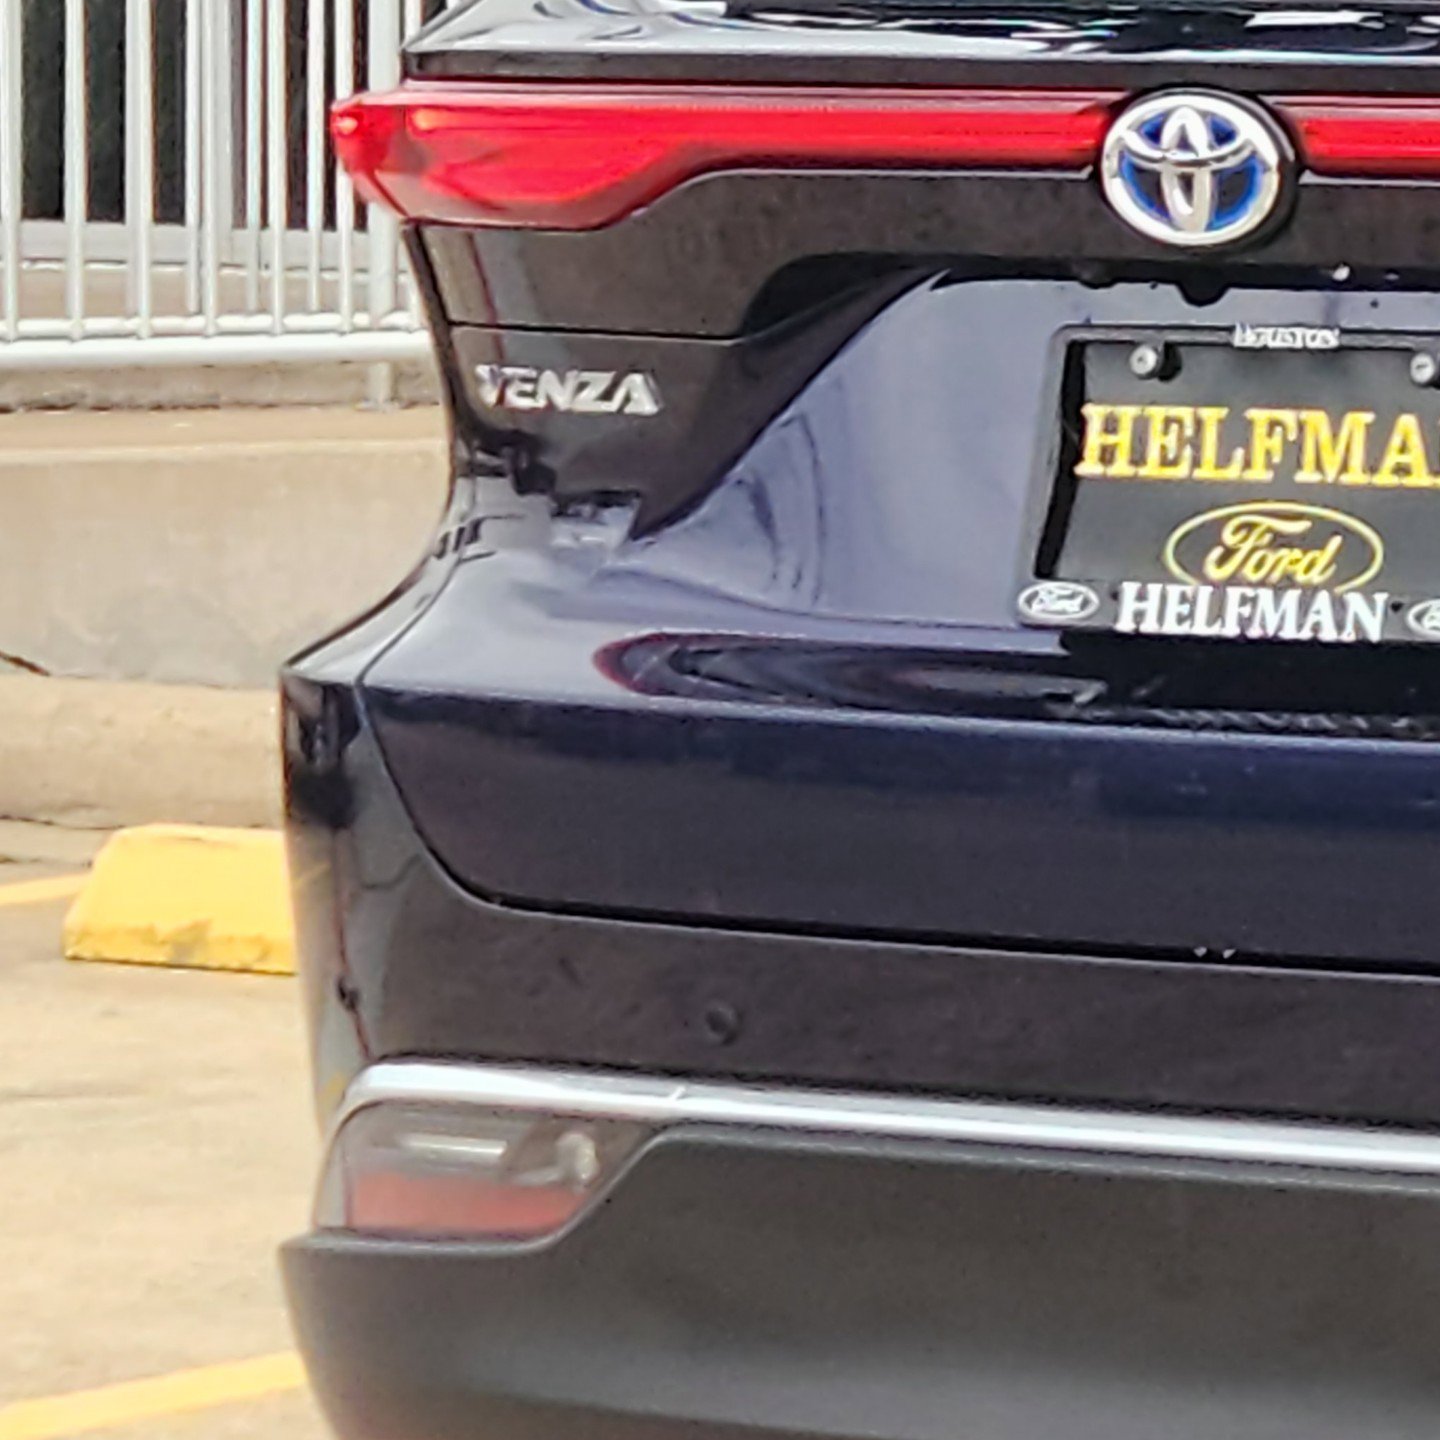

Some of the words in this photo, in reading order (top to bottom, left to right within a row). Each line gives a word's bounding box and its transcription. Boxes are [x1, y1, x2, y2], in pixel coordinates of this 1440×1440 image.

[475, 364, 664, 416] VENZA
[1203, 513, 1344, 583] Ford
[1113, 581, 1390, 643] HELFMAN
